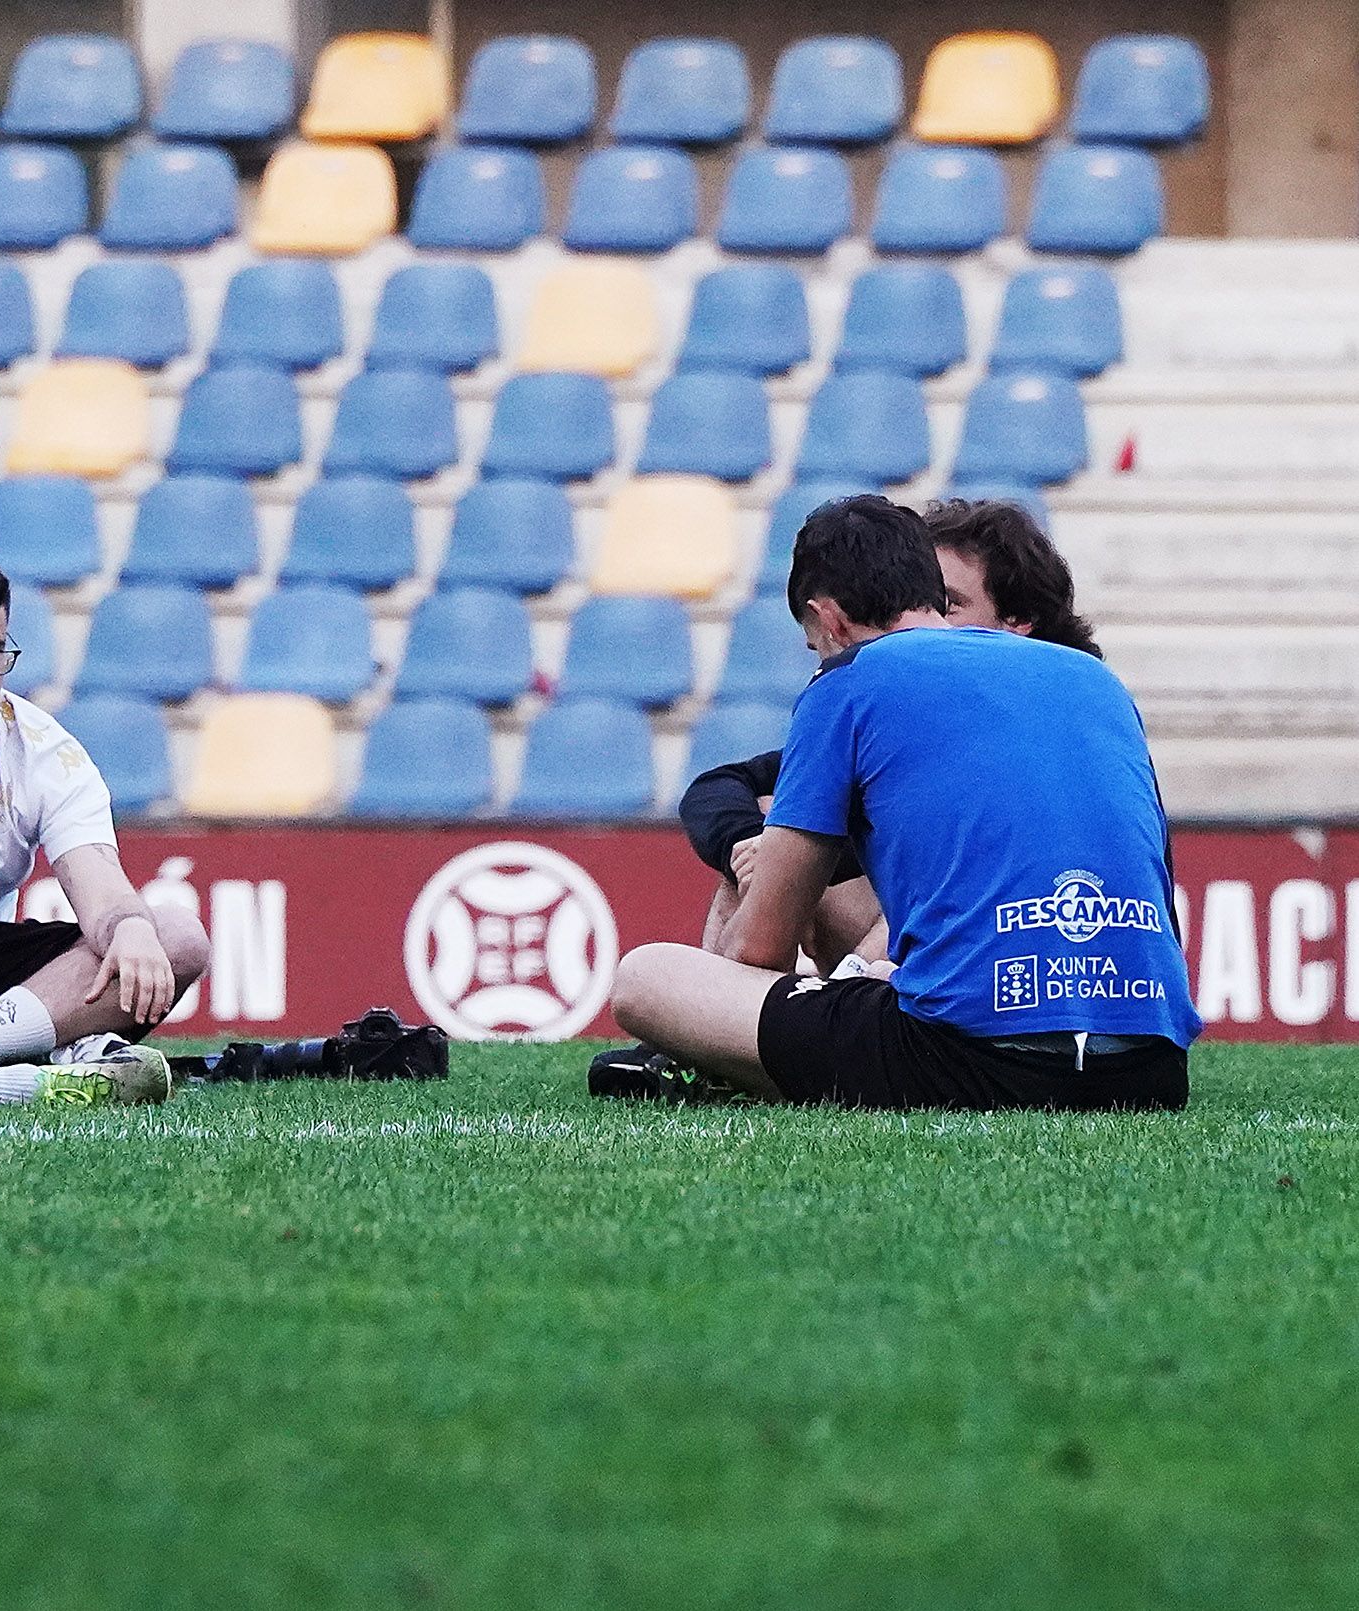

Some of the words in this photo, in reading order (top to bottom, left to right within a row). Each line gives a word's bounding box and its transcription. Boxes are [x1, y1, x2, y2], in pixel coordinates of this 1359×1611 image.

[996, 898, 1163, 933] PESCAMAR
[1046, 957, 1118, 976] XUNTA
[1046, 980, 1073, 1000] DE
[1078, 979, 1166, 1000] GALICIA
